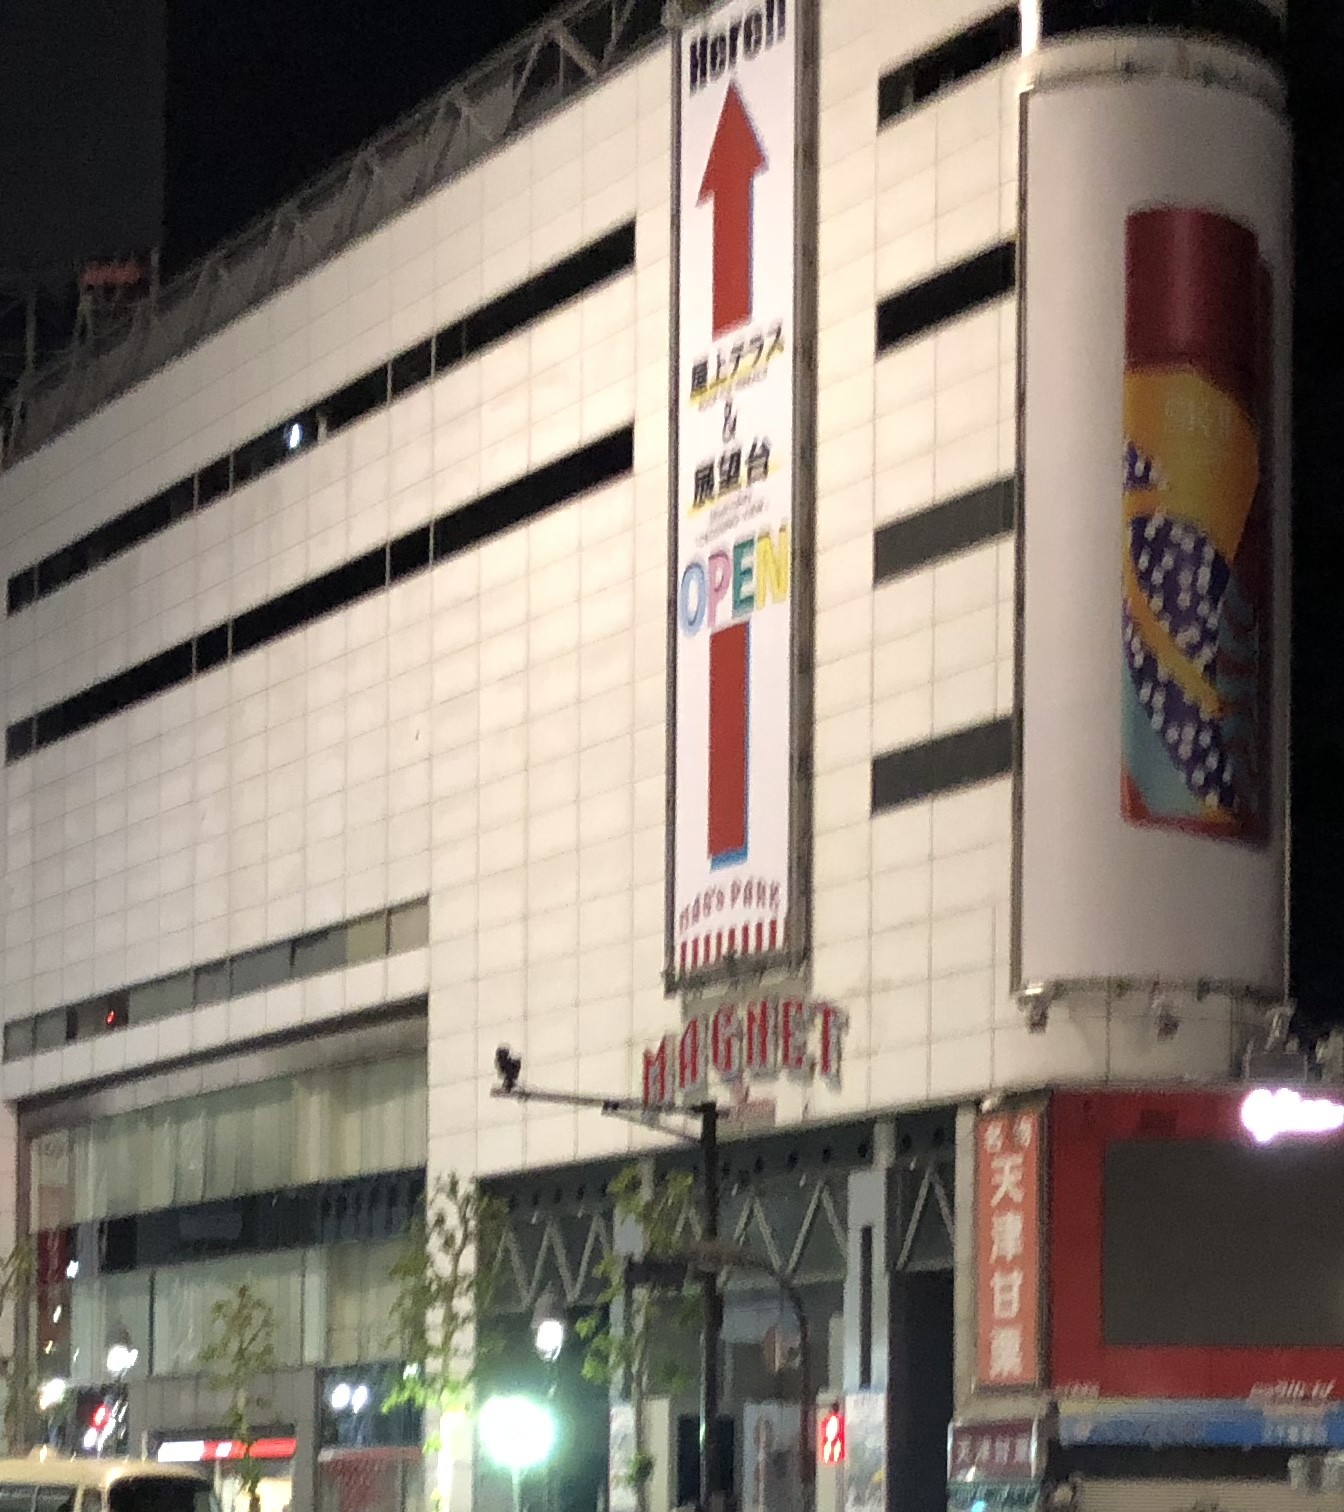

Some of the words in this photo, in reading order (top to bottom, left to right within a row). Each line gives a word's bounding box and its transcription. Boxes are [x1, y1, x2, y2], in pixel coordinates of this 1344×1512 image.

[679, 517, 792, 637] OPEN
[641, 997, 846, 1109] MAGNET
[989, 1152, 1025, 1382] 天津甘栗
